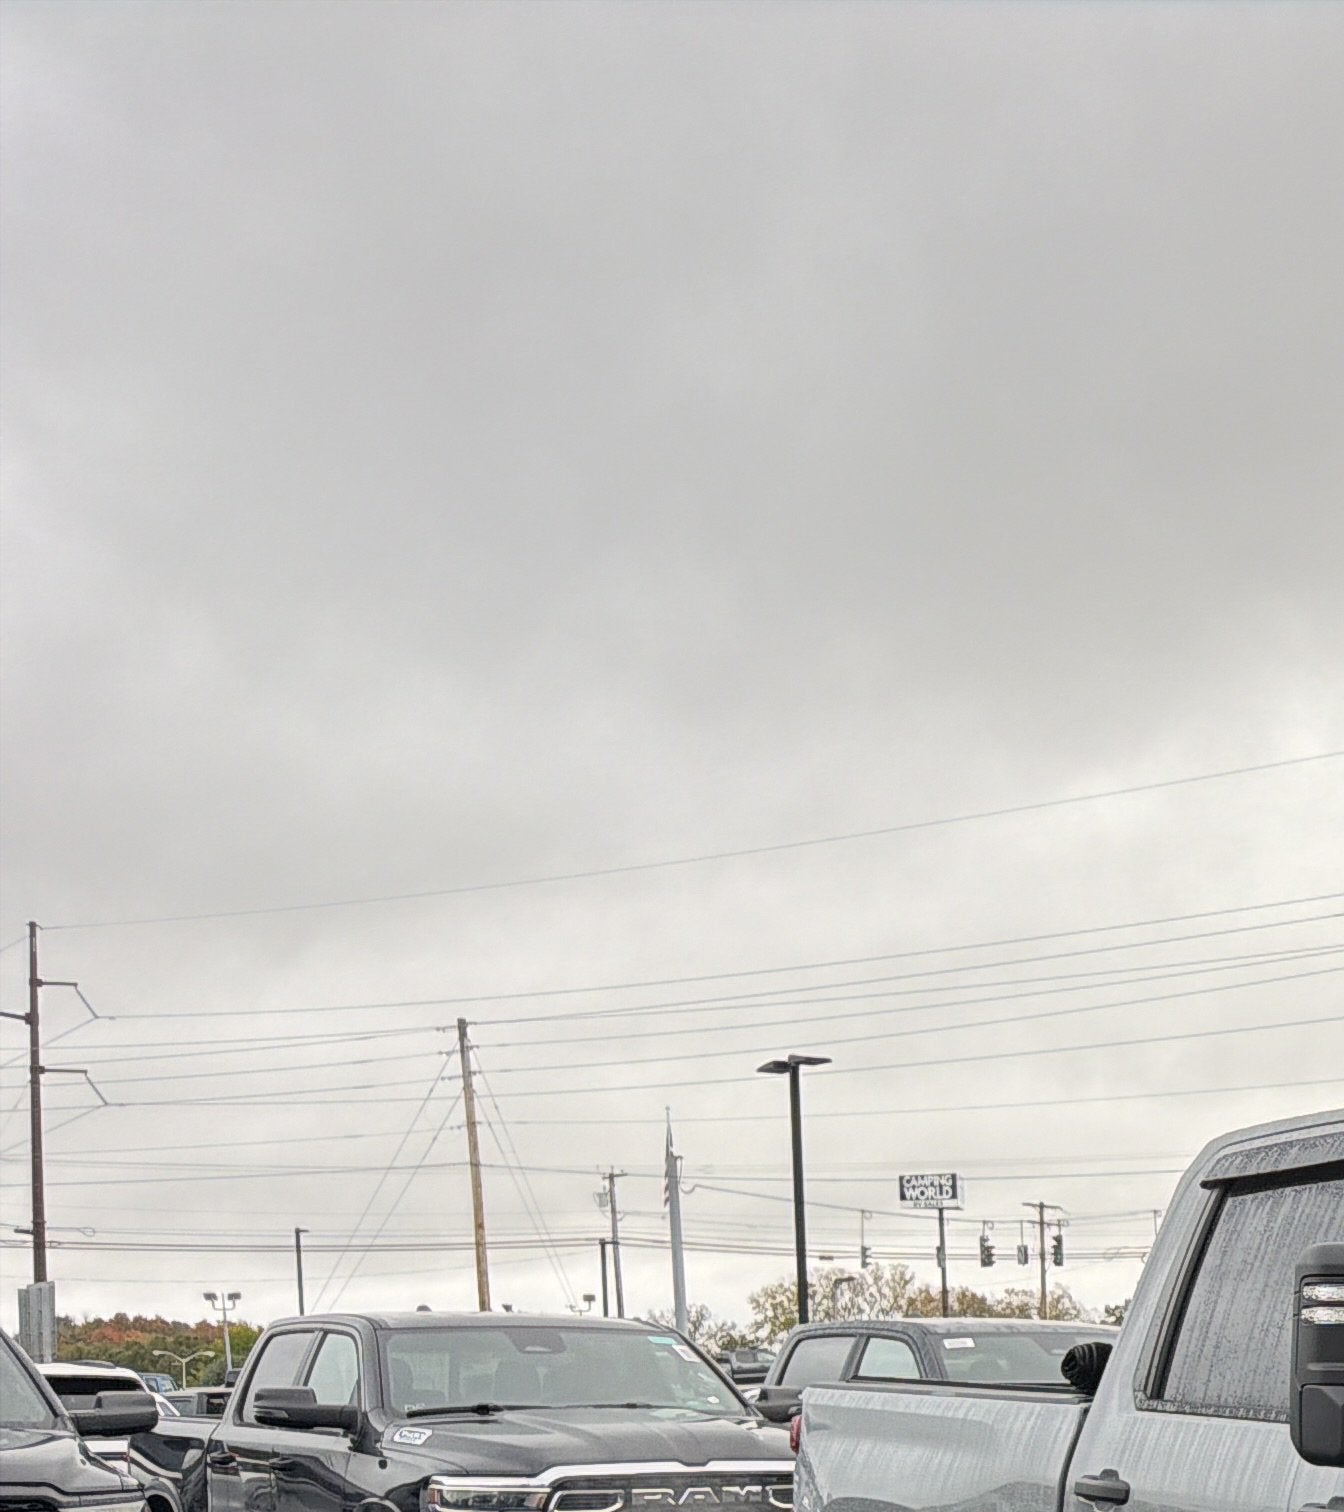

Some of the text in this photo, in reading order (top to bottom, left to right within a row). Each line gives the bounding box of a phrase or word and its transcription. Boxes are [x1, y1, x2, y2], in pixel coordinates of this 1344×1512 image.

[902, 1174, 953, 1187] CAMPING
[903, 1186, 953, 1200] WORLD
[631, 1486, 763, 1506] RAM
